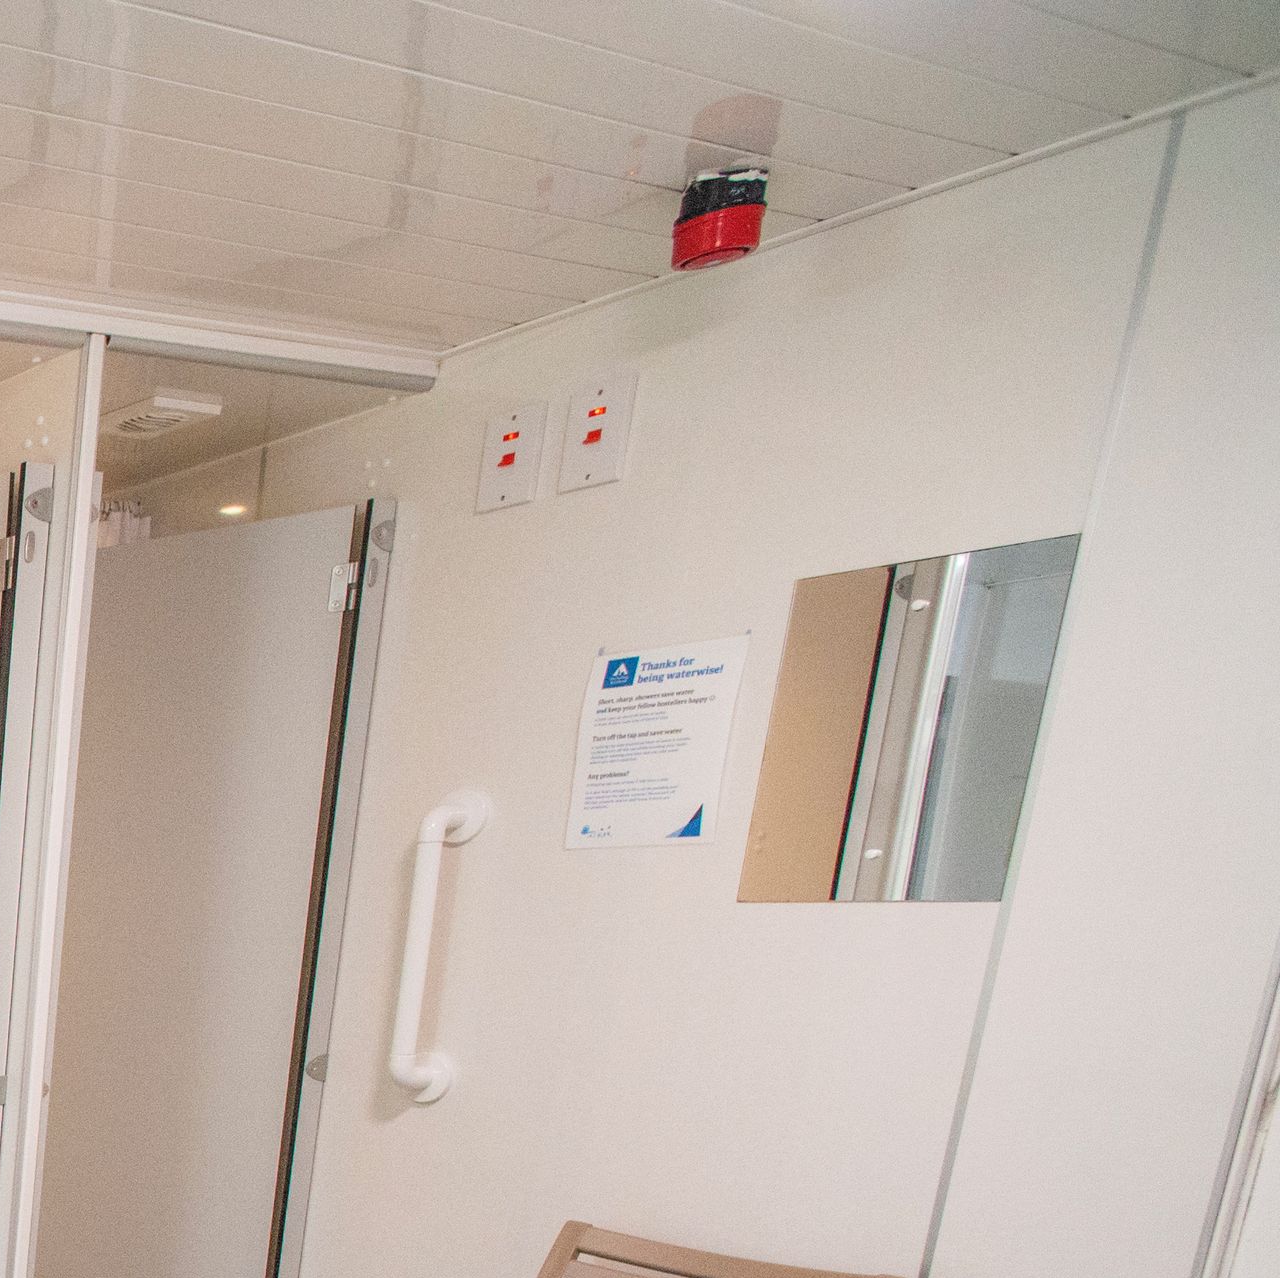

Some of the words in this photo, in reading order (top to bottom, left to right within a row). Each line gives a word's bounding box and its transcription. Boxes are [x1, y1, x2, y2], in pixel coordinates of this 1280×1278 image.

[640, 659, 677, 671] Thanks
[679, 656, 695, 667] for
[637, 673, 665, 684] being
[666, 664, 724, 680] waterwise!
[622, 705, 637, 713] your
[637, 702, 656, 710] fellow
[656, 699, 688, 707] hostellers
[688, 696, 708, 704] happy
[626, 732, 638, 740] tap
[587, 773, 599, 781] Any
[599, 770, 630, 780] problems?
